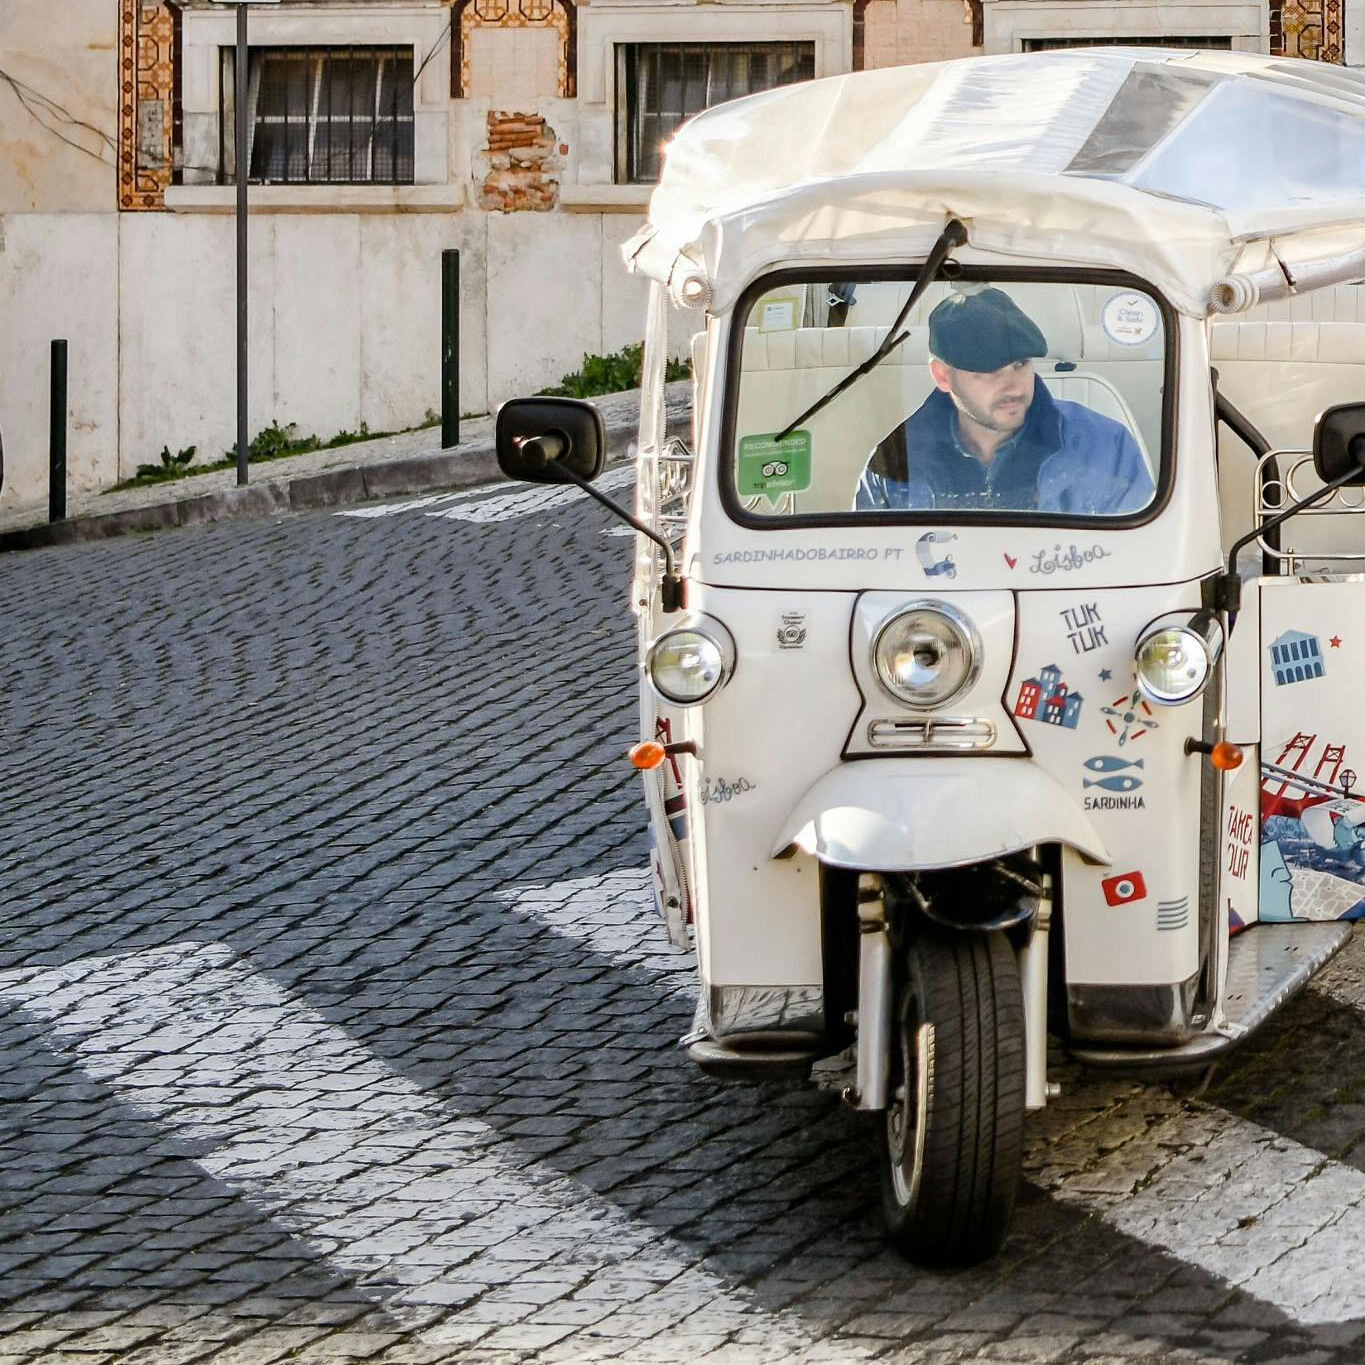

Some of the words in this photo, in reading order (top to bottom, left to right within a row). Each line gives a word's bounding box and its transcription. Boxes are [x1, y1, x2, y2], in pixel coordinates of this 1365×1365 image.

[713, 547, 878, 565] SARDINHADOBAIRRO
[884, 548, 904, 560] PT
[1029, 544, 1112, 574] Lisboa
[1060, 602, 1102, 631] TUK
[1067, 625, 1109, 654] TUK
[1084, 795, 1146, 811] SARDINHA
